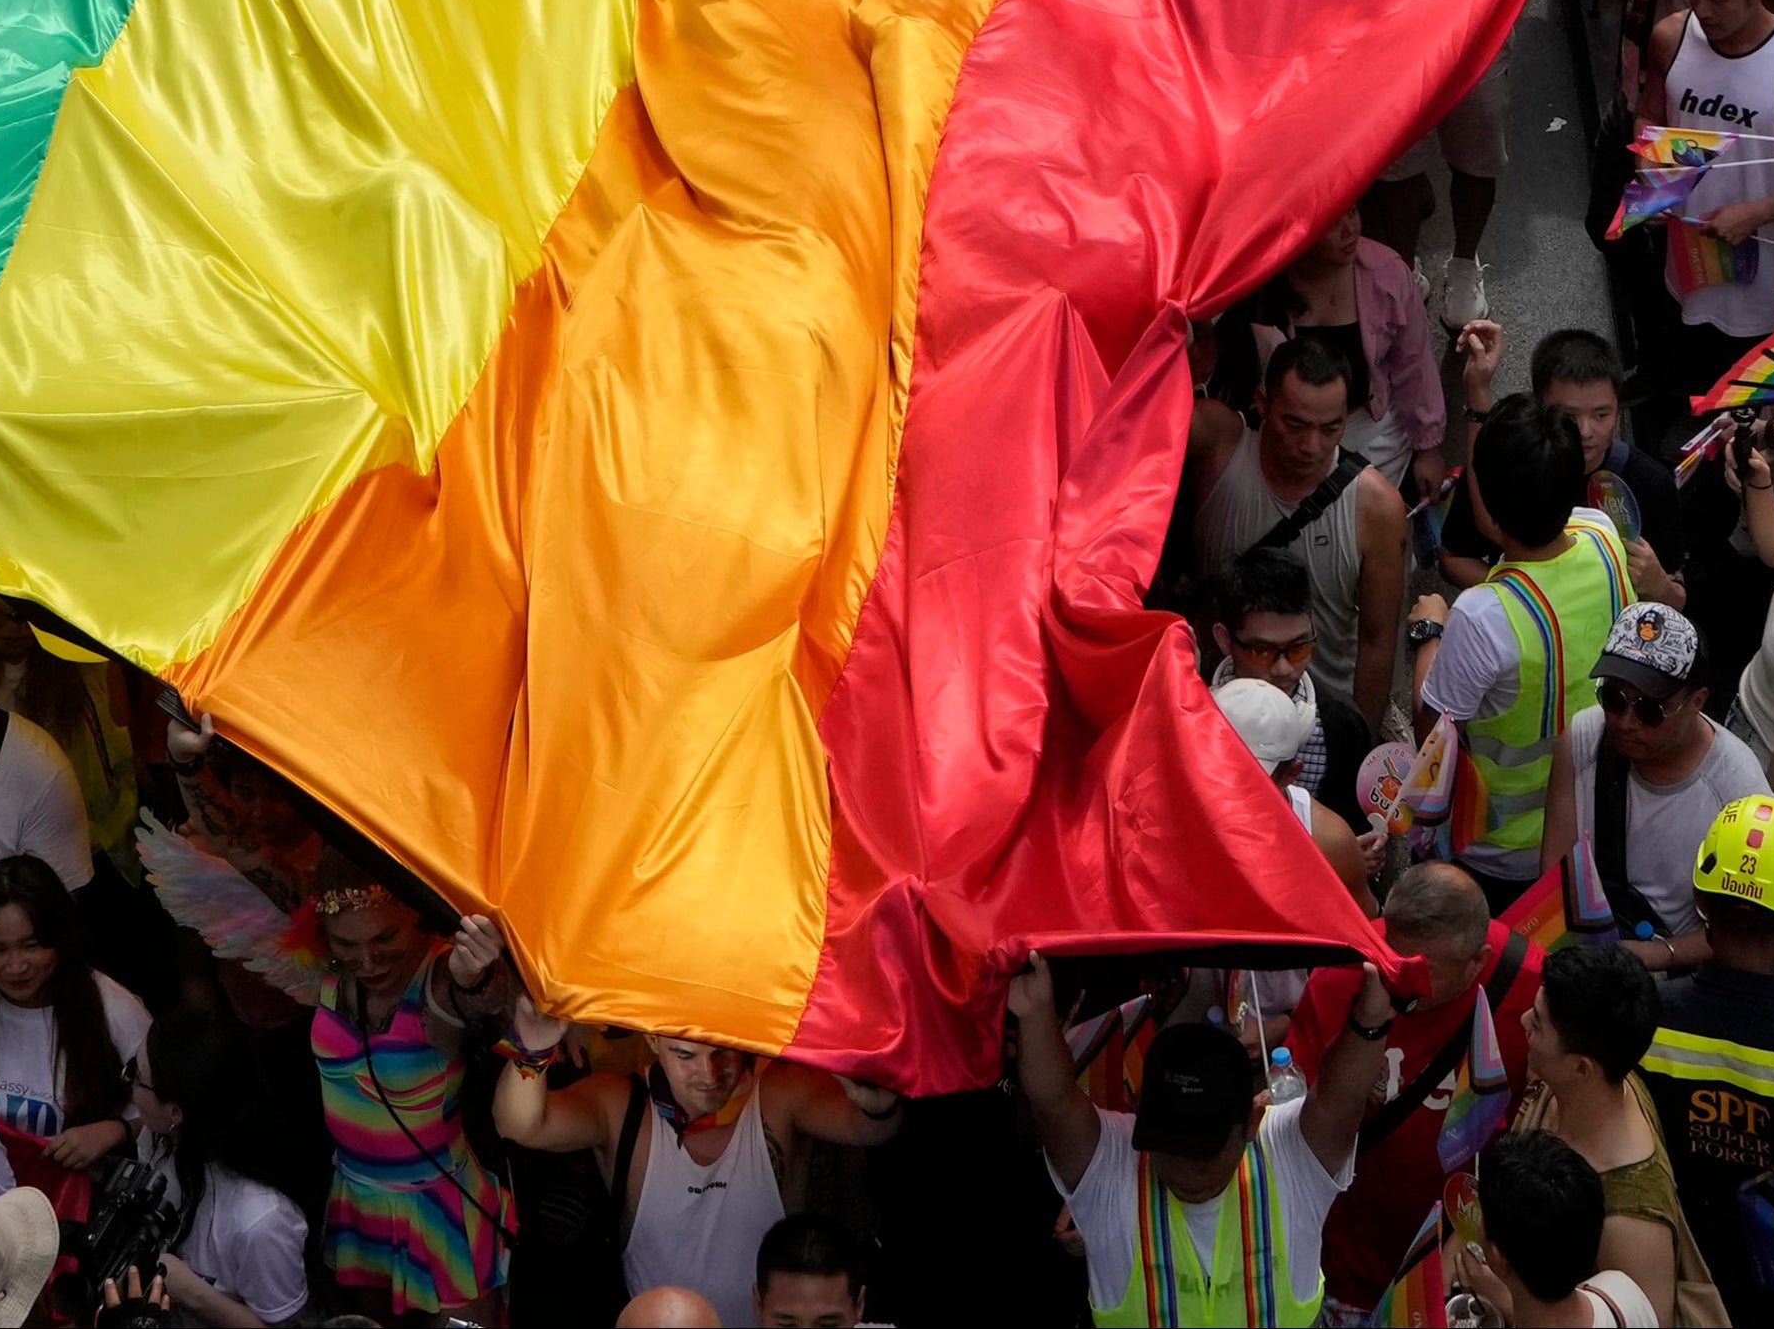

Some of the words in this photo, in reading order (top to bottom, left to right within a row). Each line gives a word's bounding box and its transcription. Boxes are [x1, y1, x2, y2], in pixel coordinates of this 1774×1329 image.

[1739, 854, 1758, 875] 23
[1720, 871, 1764, 901] ป้องกัน
[1688, 1088, 1771, 1136] SPF
[1688, 1123, 1772, 1155] SUPER
[1688, 1142, 1772, 1169] FORCE
